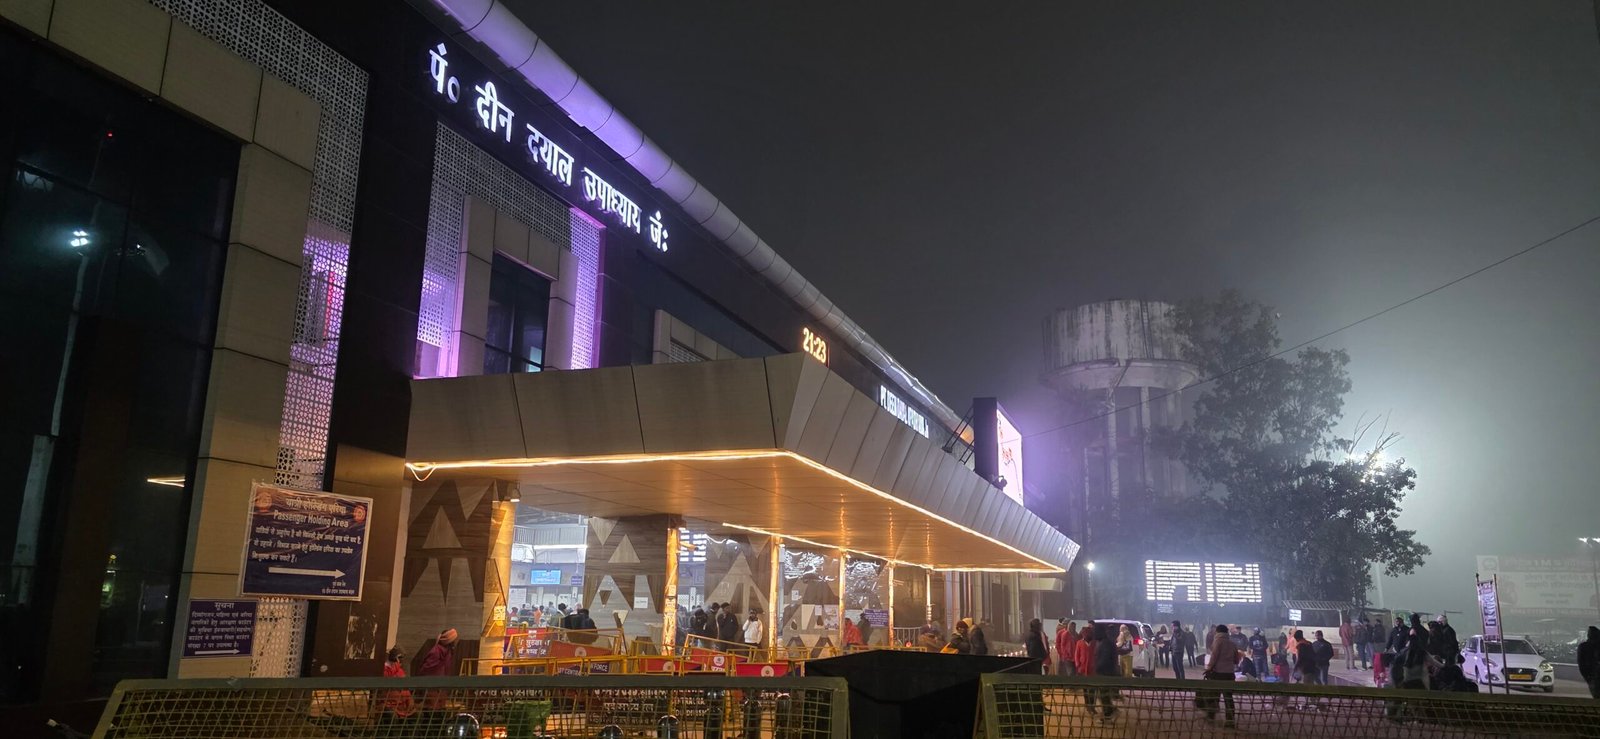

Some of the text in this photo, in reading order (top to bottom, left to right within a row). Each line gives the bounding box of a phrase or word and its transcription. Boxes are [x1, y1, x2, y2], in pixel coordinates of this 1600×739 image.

[475, 81, 515, 143] दीन
[526, 123, 575, 186] दयाल
[582, 166, 641, 234] उपाध्याय
[803, 327, 827, 363] 21:23
[285, 496, 346, 515] यात्री होल्डिंग एरिया
[273, 510, 349, 528] Passenger Holding Area
[214, 602, 235, 611] सूचना
[593, 662, 609, 672] FORCE
